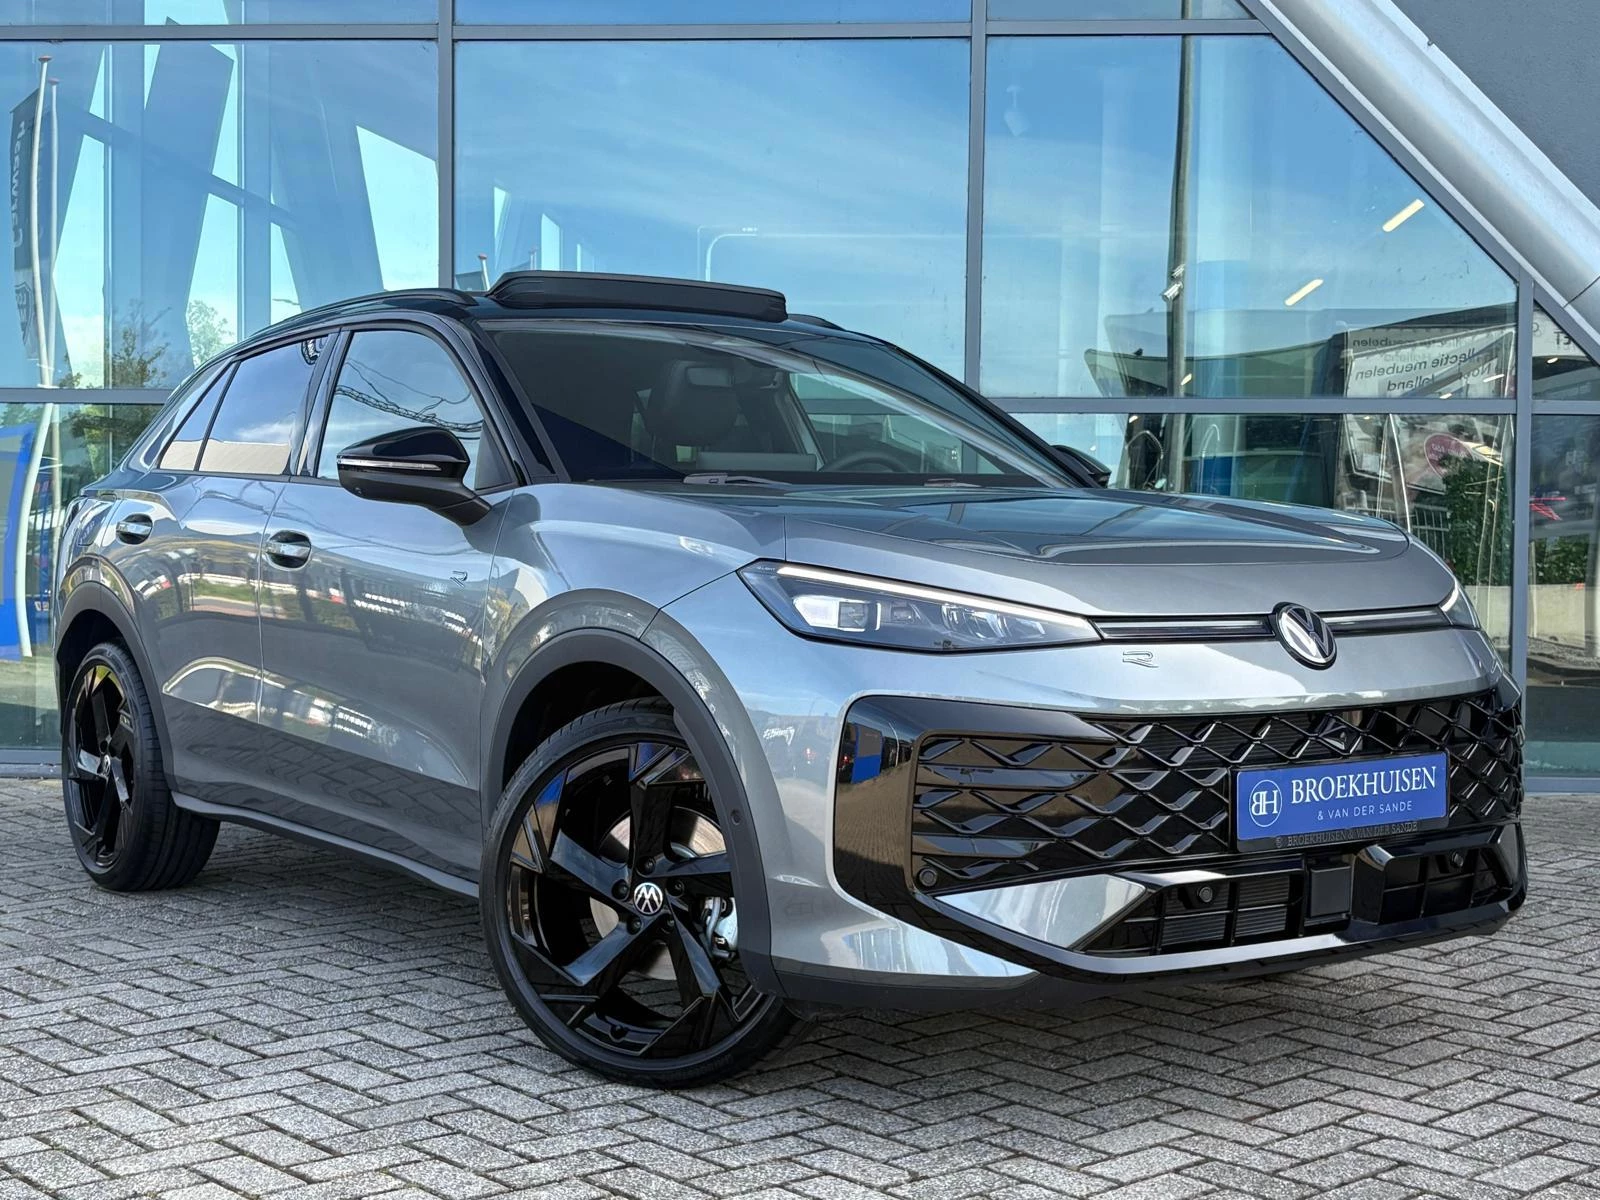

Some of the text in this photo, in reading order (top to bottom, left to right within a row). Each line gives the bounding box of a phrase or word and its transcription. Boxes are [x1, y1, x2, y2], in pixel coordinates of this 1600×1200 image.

[1291, 766, 1437, 804] BROEKHUISEN
[1317, 800, 1413, 821] & VAN DER SANDE
[1287, 830, 1347, 847] BROEKHUISEN
[1356, 827, 1374, 839] VAN
[1391, 821, 1418, 834] SANDE
